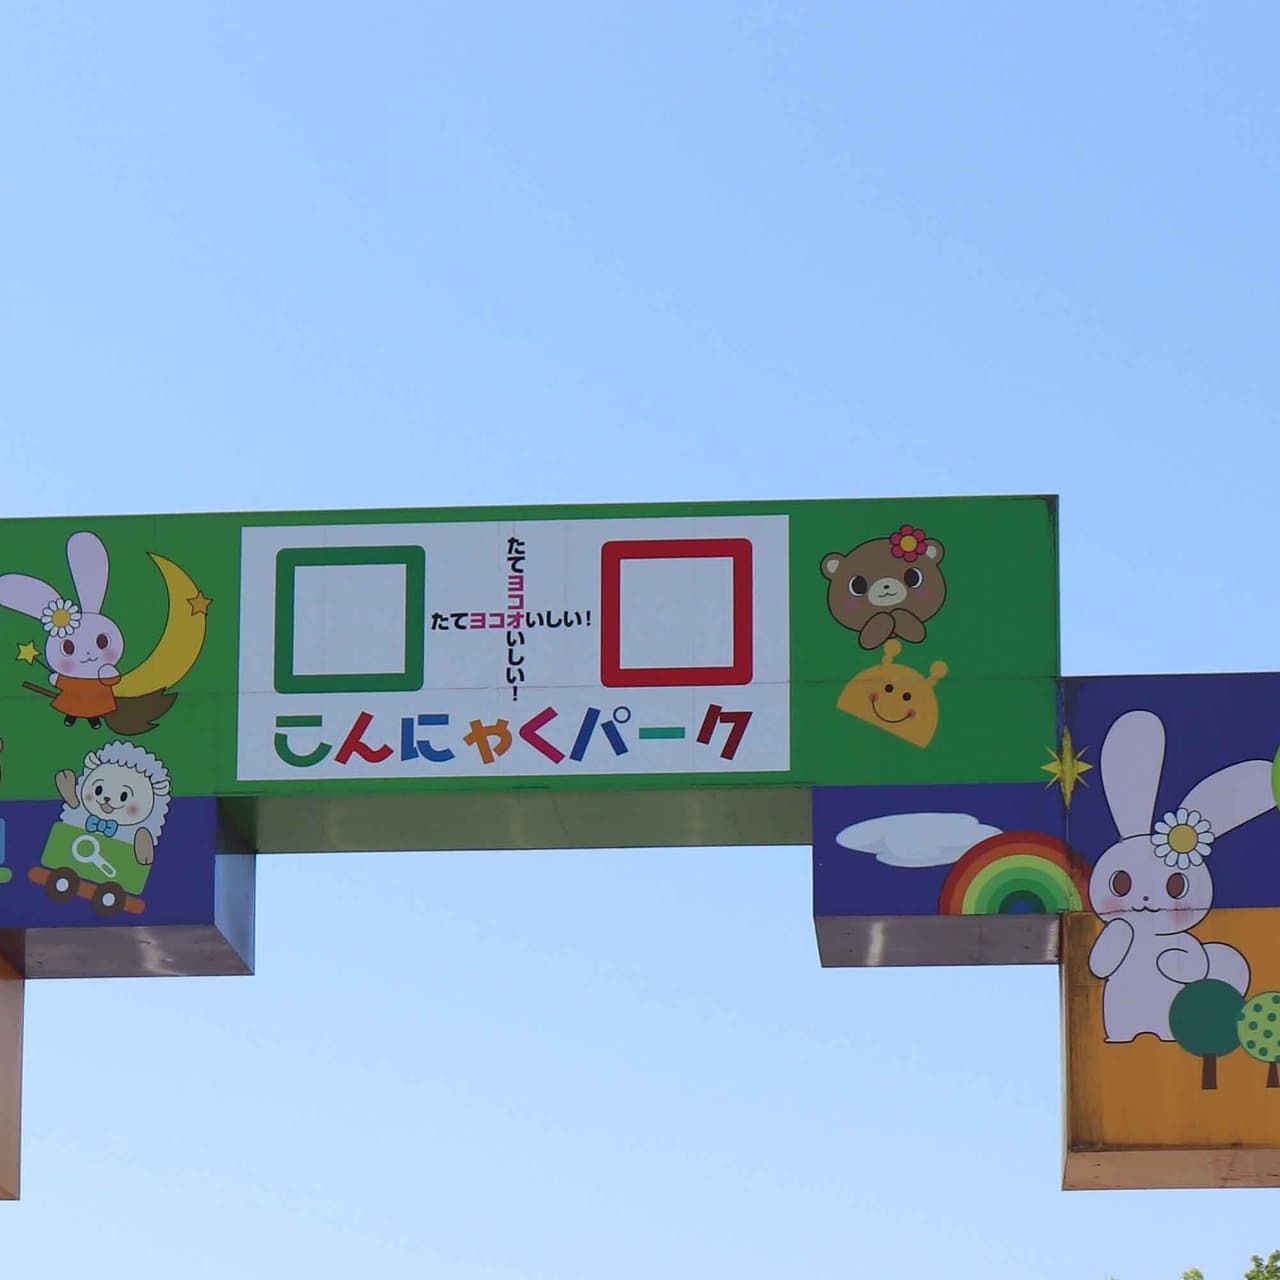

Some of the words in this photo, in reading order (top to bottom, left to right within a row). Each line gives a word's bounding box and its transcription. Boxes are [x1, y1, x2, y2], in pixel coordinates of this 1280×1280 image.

[273, 703, 753, 768] こんにゃくパーク
